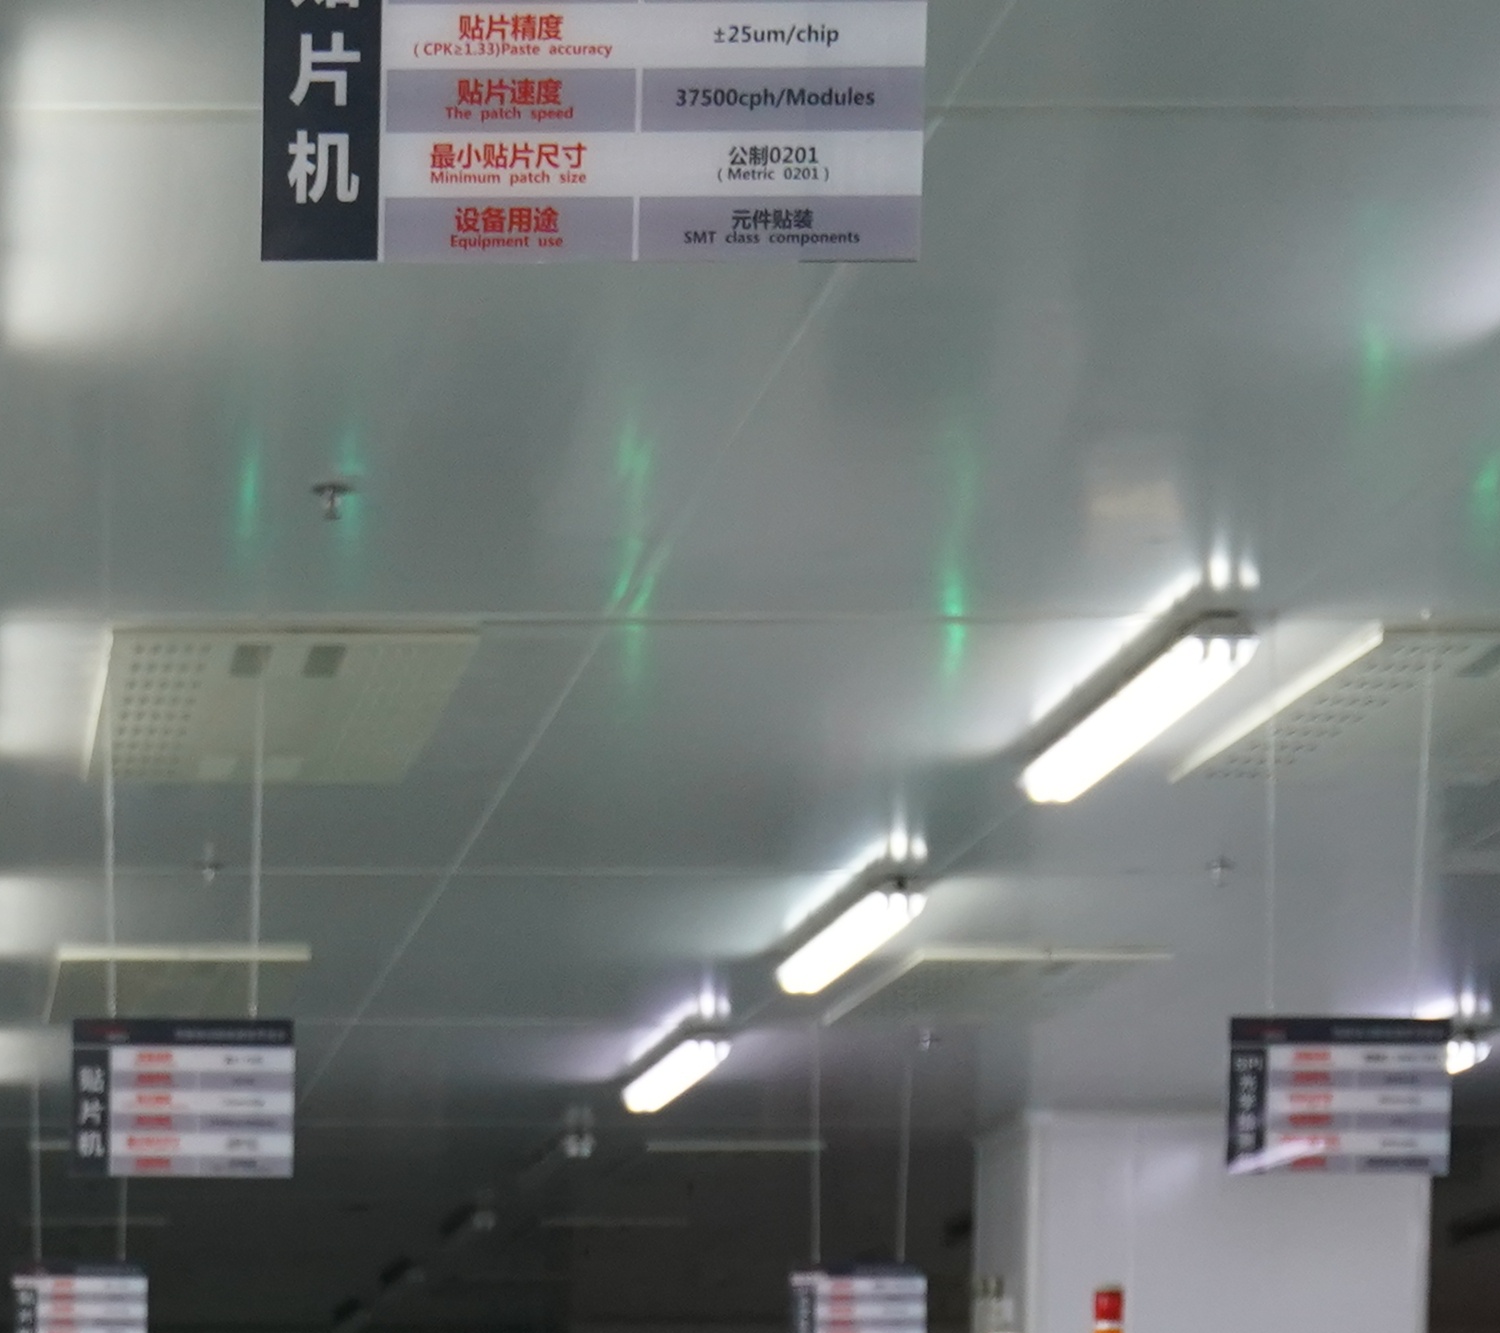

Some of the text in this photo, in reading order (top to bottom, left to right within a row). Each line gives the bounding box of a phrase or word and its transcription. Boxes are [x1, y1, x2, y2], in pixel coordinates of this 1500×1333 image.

[459, 14, 564, 42] 贴片精度
[712, 22, 840, 48] ±25um/chip
[549, 42, 614, 59] accuracy
[288, 0, 361, 205] 片机
[456, 78, 562, 106] 贴片速度
[675, 86, 876, 110] 37500cph/Modules
[444, 107, 574, 124] The patch speed
[430, 142, 588, 170] 最小贴片尺寸
[728, 145, 819, 166] 公制0201
[430, 171, 587, 188] Minimum patch size
[454, 206, 560, 235] 设备用途
[731, 209, 814, 231] 元件贴装
[450, 235, 564, 250] Equipment use
[684, 231, 861, 248] SMT class components
